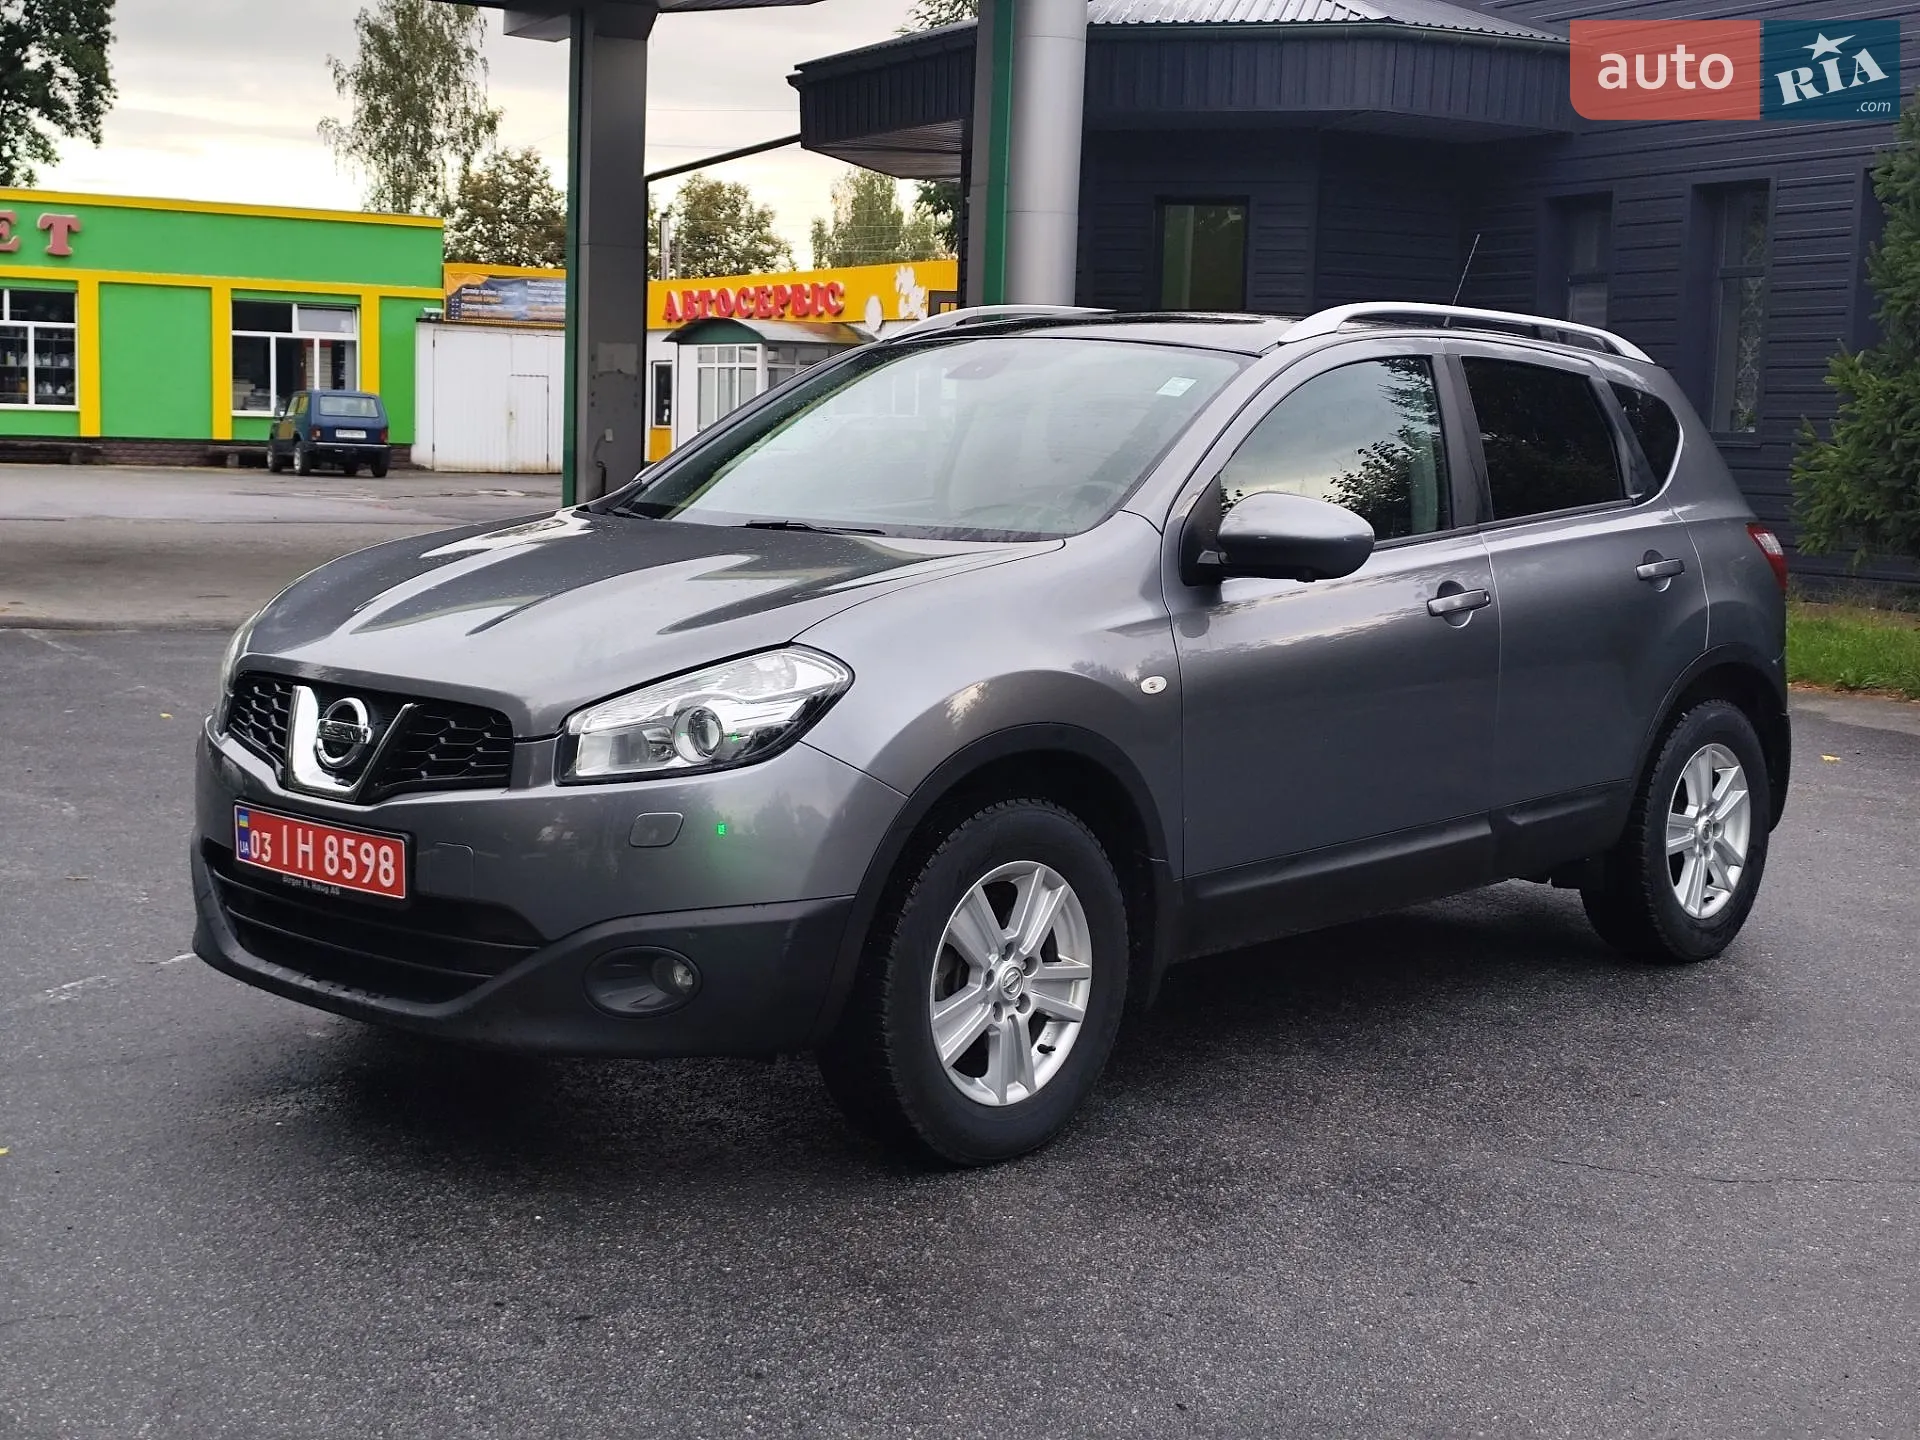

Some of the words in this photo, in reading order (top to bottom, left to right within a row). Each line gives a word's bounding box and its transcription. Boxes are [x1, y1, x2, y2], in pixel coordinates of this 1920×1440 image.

[662, 281, 845, 322] АВТОСЕРВІС
[239, 839, 249, 855] UA
[251, 829, 272, 863] 03
[324, 835, 395, 888] 8598
